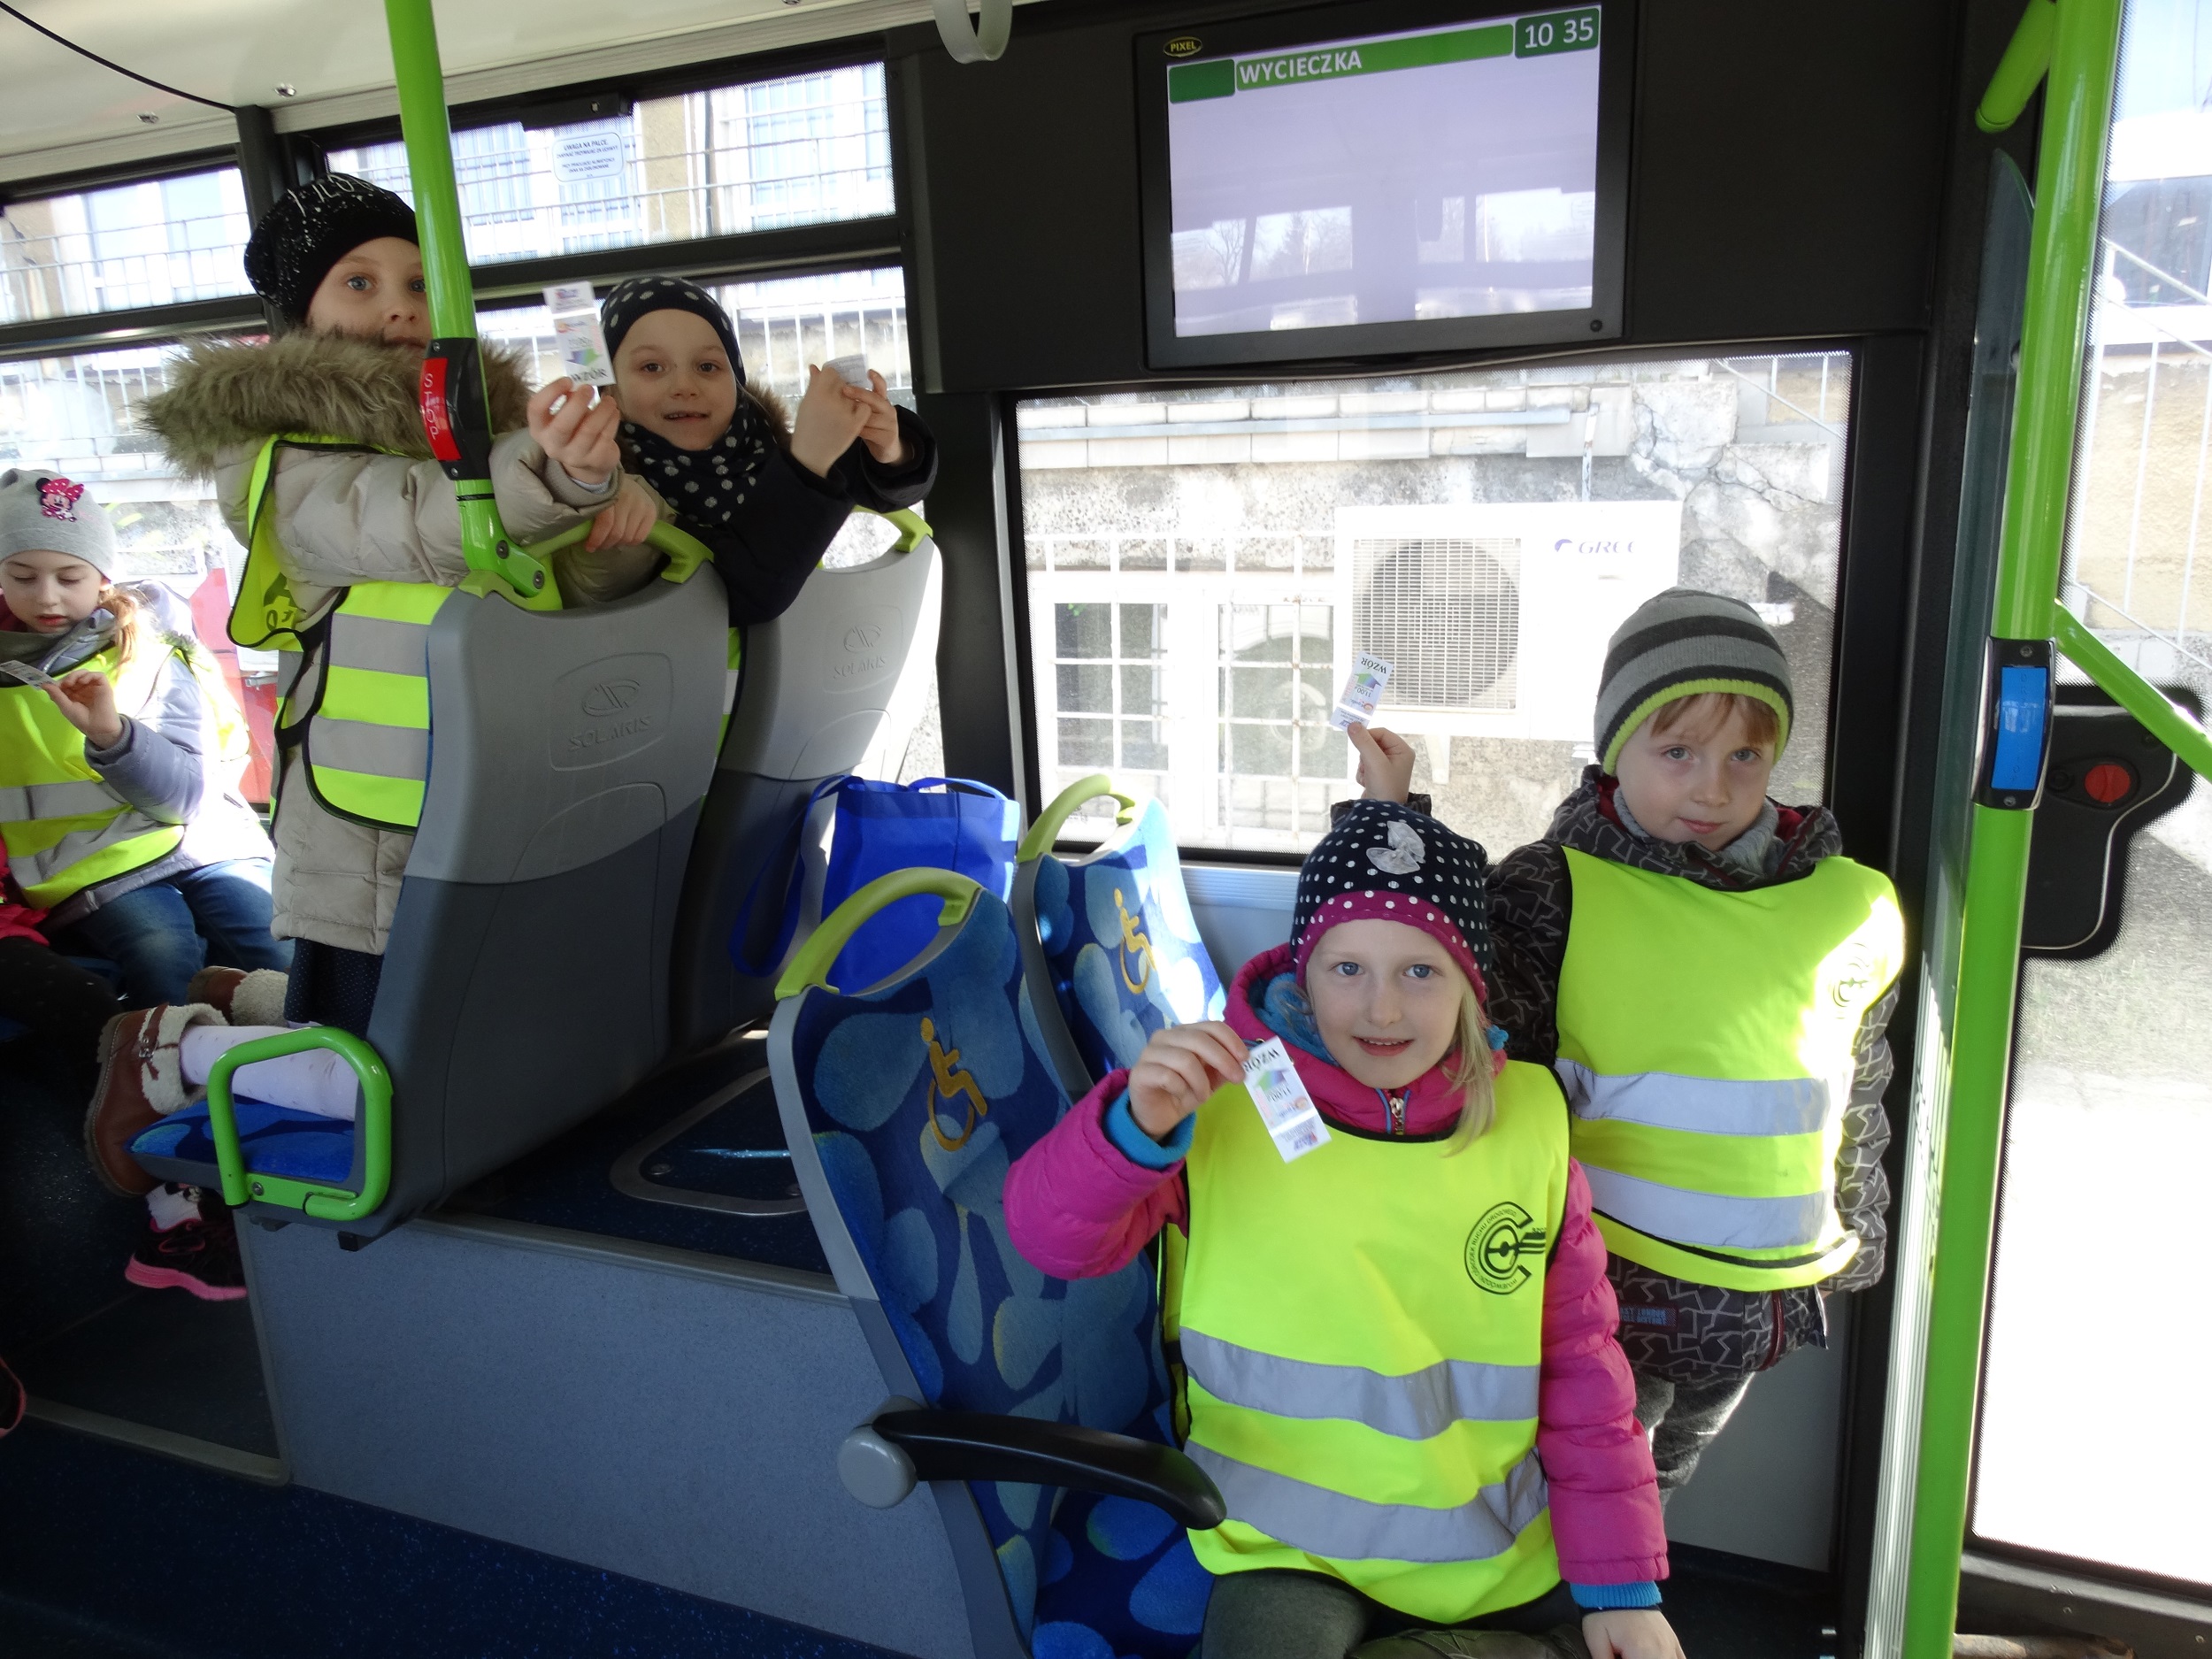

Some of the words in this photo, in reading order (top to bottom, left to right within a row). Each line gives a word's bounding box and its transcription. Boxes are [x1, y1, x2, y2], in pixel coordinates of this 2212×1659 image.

[1169, 41, 1197, 54] PIXEL
[1240, 52, 1363, 84] WYCIECZKA
[1525, 22, 1554, 49] 10
[1563, 17, 1594, 42] 35
[424, 373, 440, 441] STOP
[1361, 657, 1387, 674] WZÓR
[568, 716, 652, 752] SOLARIS
